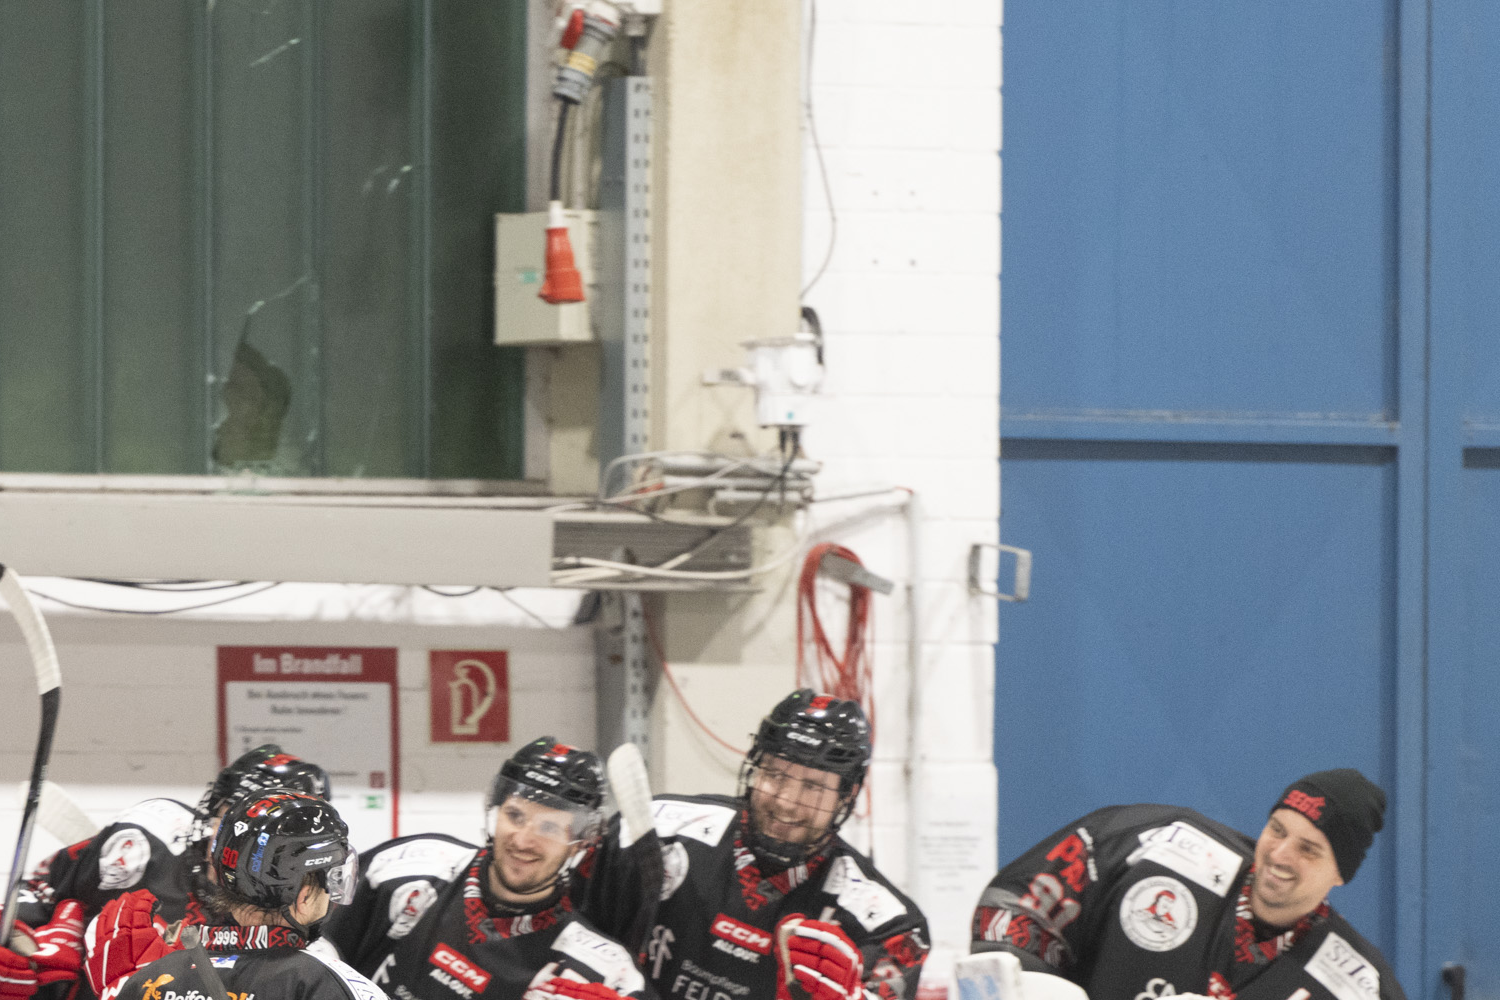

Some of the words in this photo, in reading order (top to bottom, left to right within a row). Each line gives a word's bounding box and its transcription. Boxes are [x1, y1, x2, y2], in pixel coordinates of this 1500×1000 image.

[305, 856, 333, 867] CCM
[214, 930, 238, 947] 1996
[714, 919, 774, 949] CCM
[434, 949, 488, 987] CCM
